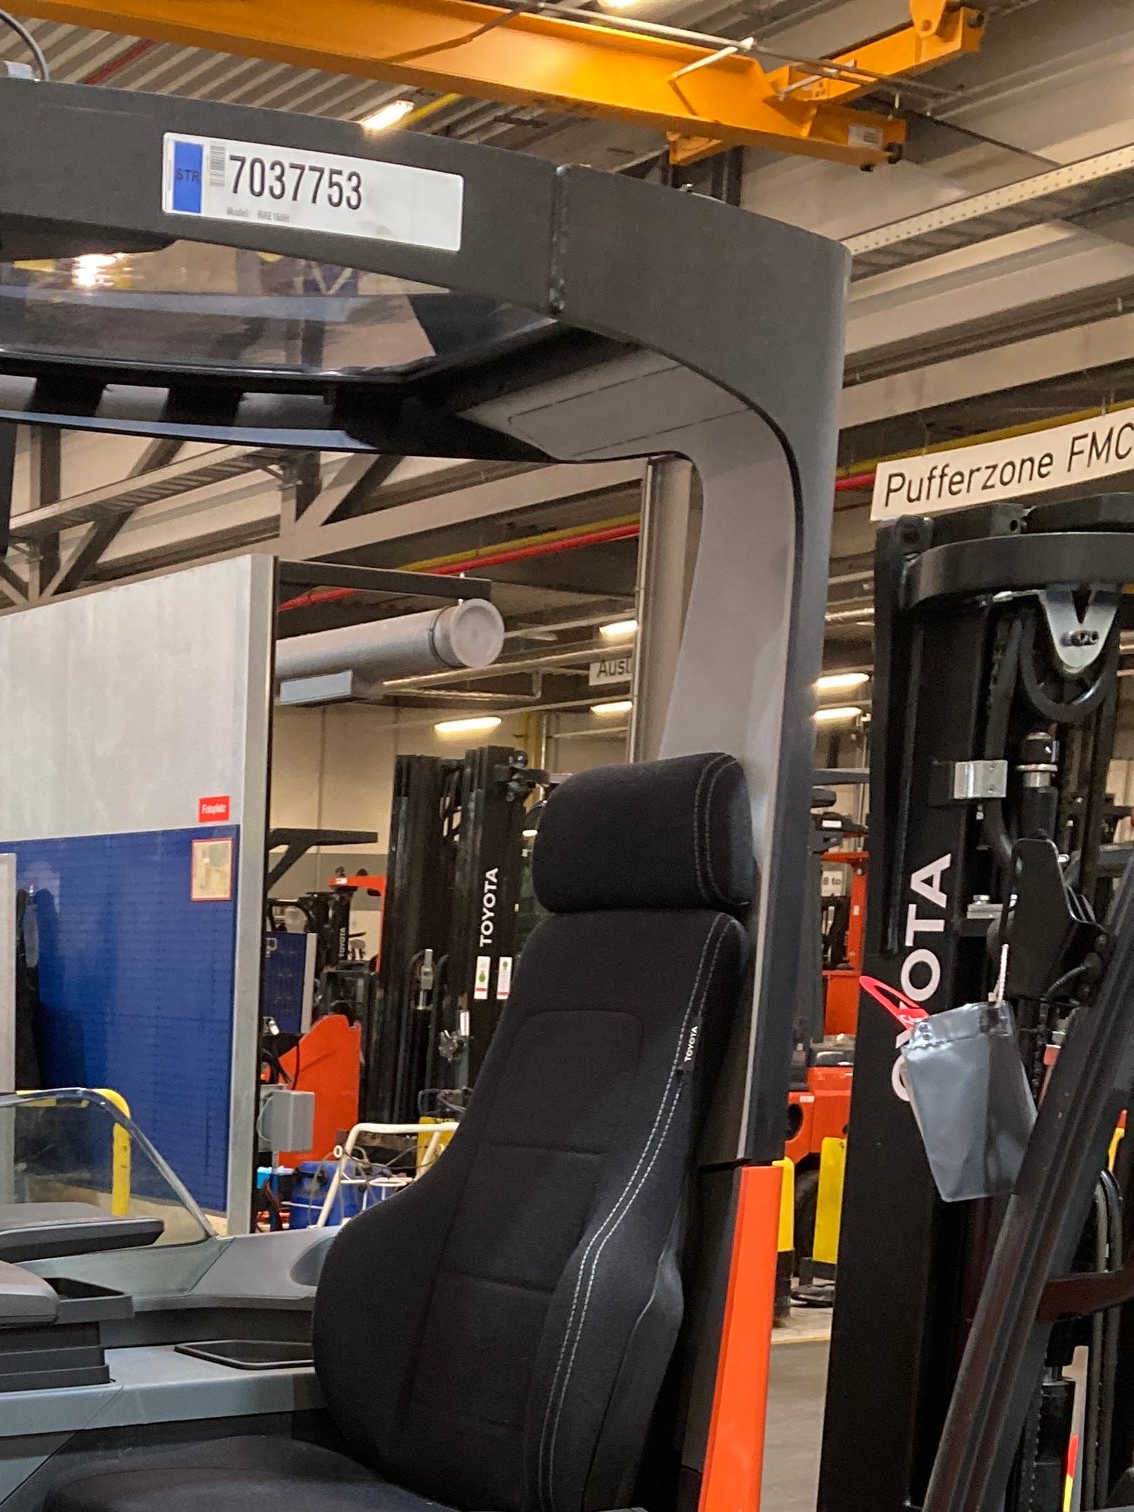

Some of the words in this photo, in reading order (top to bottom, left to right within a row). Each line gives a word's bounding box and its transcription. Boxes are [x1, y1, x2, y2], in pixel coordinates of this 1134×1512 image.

[175, 167, 201, 182] STR
[229, 154, 363, 211] 7037753
[884, 451, 1054, 508] Pufferzone
[1067, 422, 1134, 473] FMC
[479, 867, 499, 948] TOYOTA
[338, 926, 347, 958] TOYOTA
[684, 1025, 699, 1063] TOYOTA
